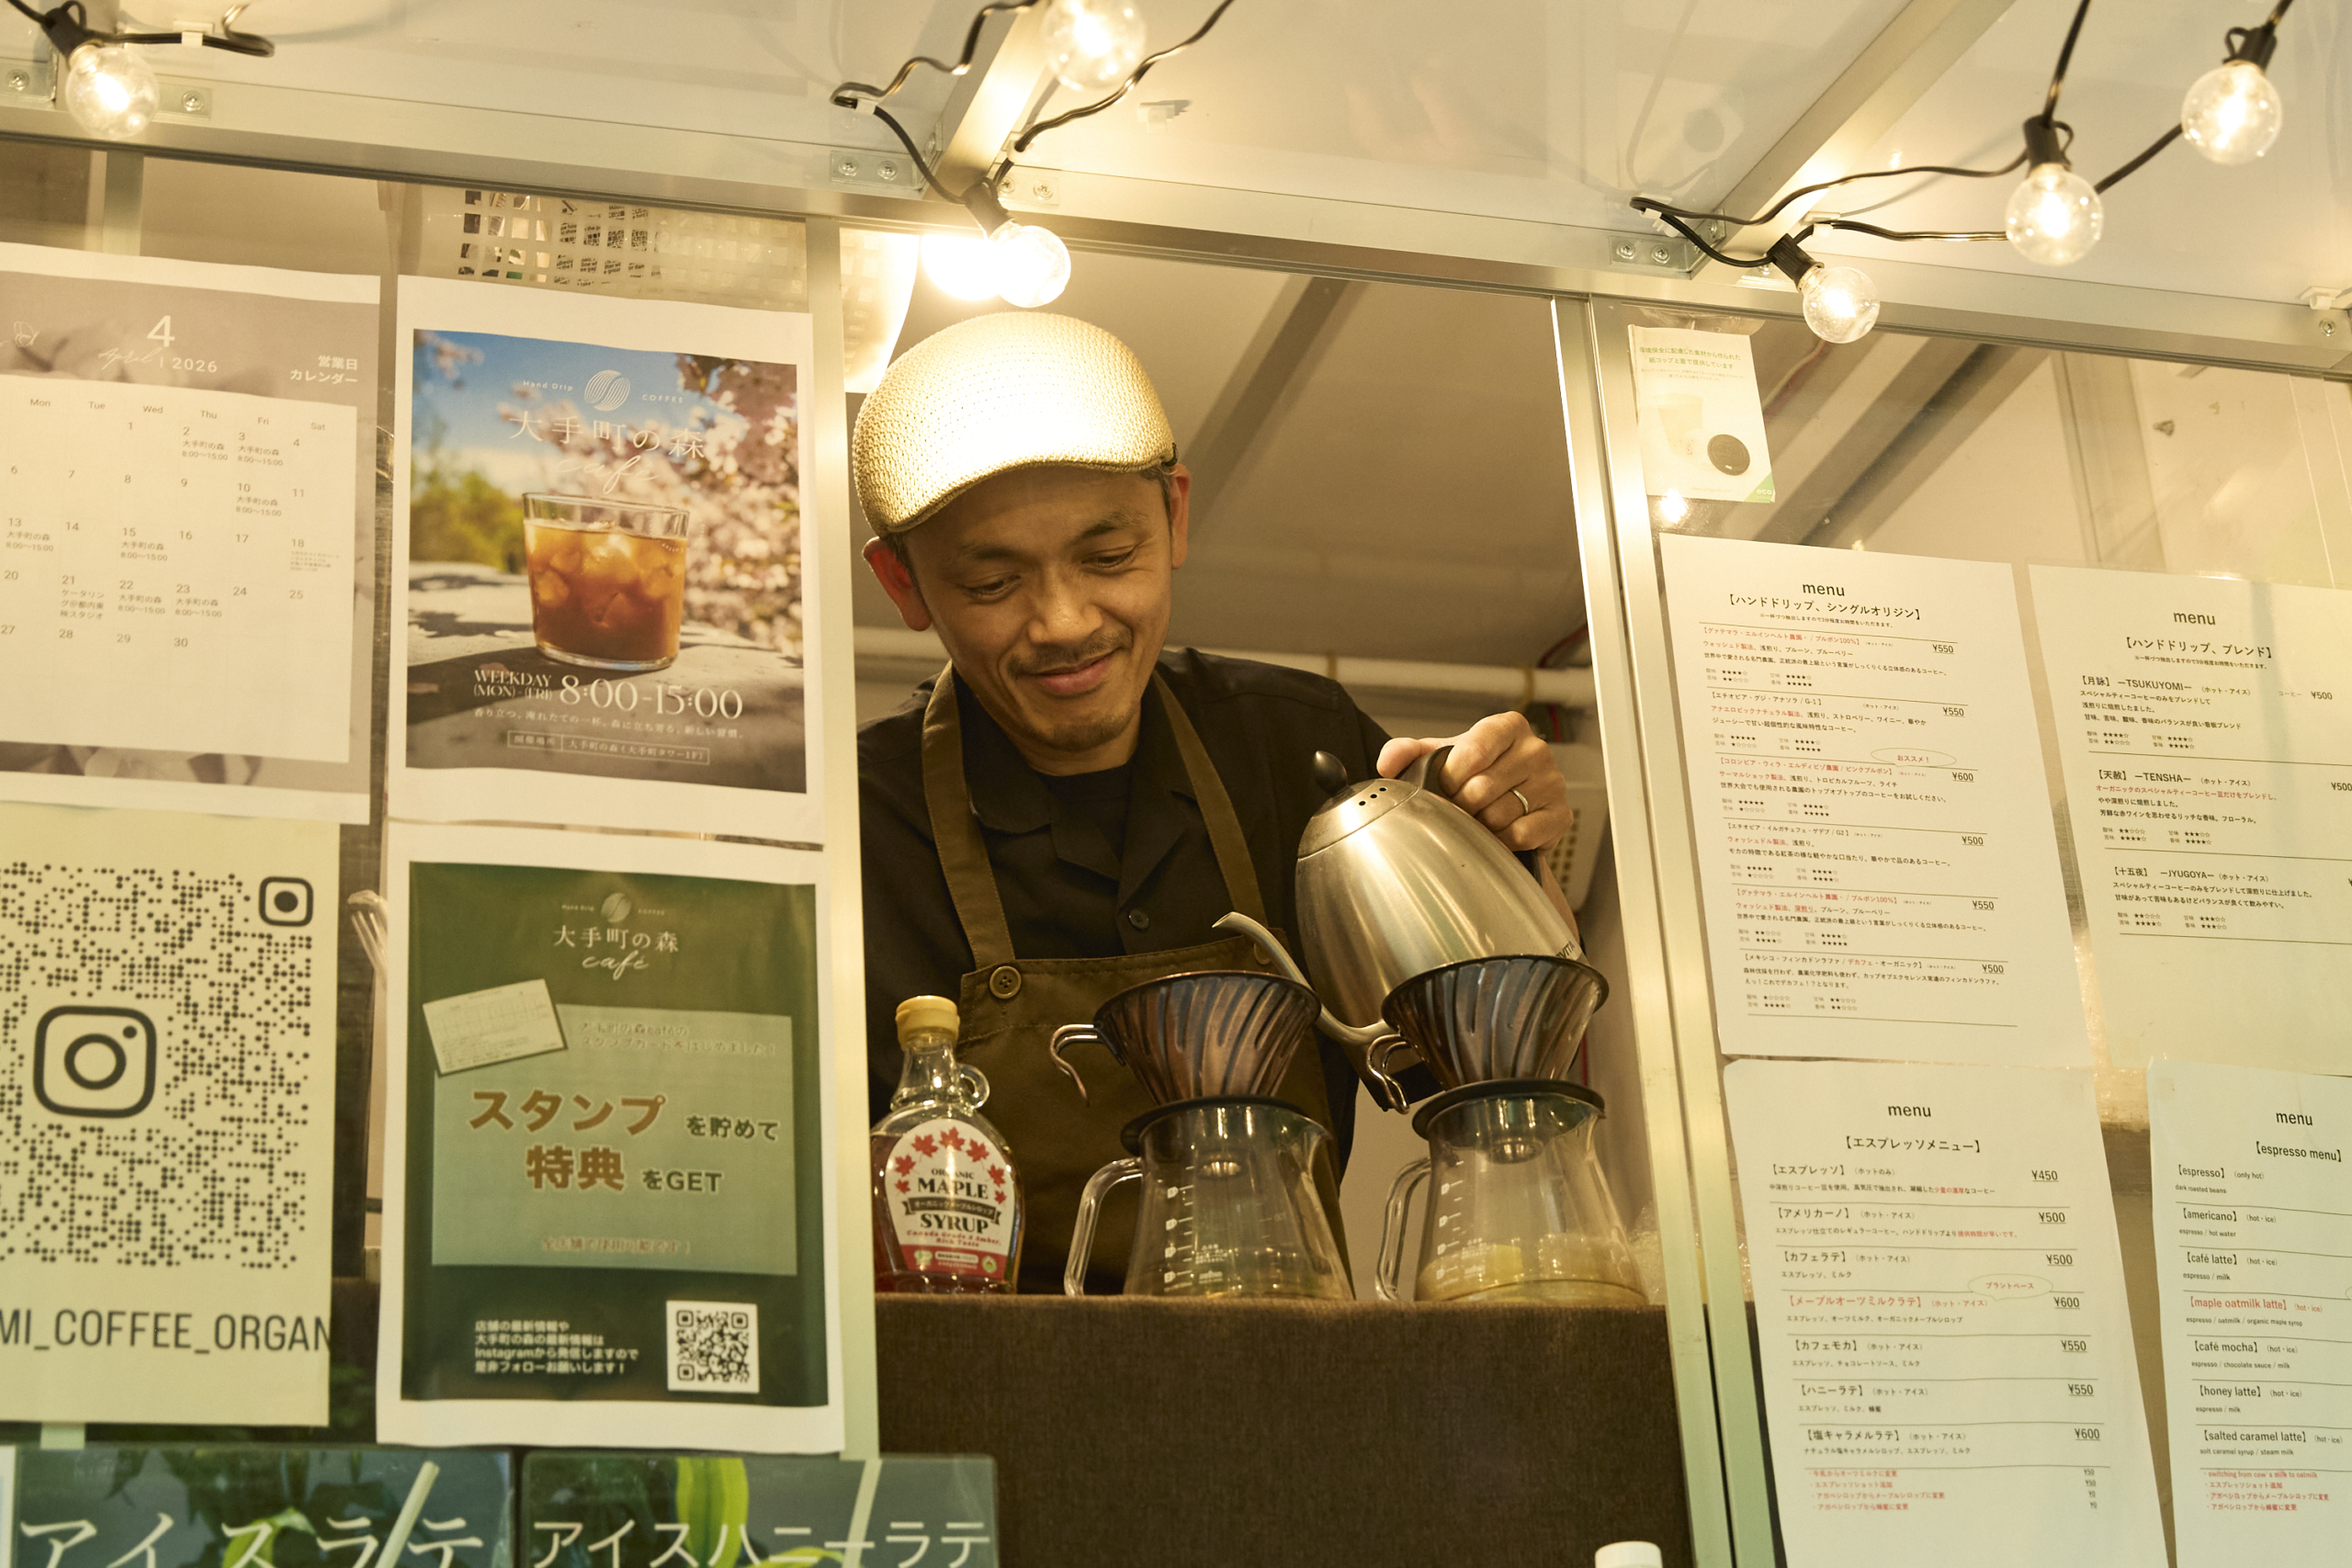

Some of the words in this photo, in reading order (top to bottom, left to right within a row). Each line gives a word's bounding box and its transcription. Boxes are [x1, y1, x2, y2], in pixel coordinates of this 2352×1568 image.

[146, 314, 175, 347] 4
[172, 357, 218, 374] 2026
[318, 355, 358, 370] 営業日
[289, 368, 358, 385] カレンダー
[523, 380, 548, 390] Hand
[552, 382, 573, 392] Drip
[642, 394, 684, 403] COFFEE
[29, 399, 51, 408] Mon
[88, 401, 106, 410] Tue
[142, 405, 164, 414] Wed
[200, 410, 218, 420] Thu
[258, 416, 269, 426] Fri
[311, 421, 326, 431] Sat
[128, 422, 133, 431] 1
[183, 426, 190, 436] 2
[238, 432, 245, 441] 3
[293, 438, 300, 447] 4
[509, 411, 705, 459] 大手町の森
[11, 466, 17, 475] 6
[68, 470, 75, 479] 7
[124, 475, 131, 484] 8
[181, 479, 187, 488] 9
[238, 483, 251, 492] 10
[293, 489, 305, 497] 11
[7, 517, 22, 527] 13
[65, 522, 80, 531] 14
[122, 527, 136, 536] 15
[179, 531, 193, 540] 16
[235, 534, 249, 543] 17
[291, 538, 305, 547] 18
[4, 570, 18, 581] 20
[62, 575, 75, 585] 21
[119, 581, 134, 590] 22
[175, 584, 190, 594] 23
[232, 587, 247, 596] 24
[289, 590, 303, 600] 25
[1803, 582, 1845, 597] menu
[1729, 593, 1921, 621] 【ハンドドリップ、シングルオリジン】
[2174, 612, 2216, 626] menu
[1, 625, 16, 635] 27
[59, 629, 74, 639] 28
[117, 634, 130, 643] 29
[175, 638, 188, 648] 30
[1933, 644, 1954, 653] ¥550
[2126, 637, 2272, 659] 【ハンドドリップ、ブレンド】
[475, 670, 552, 688] WEEKDAY
[2311, 691, 2333, 701] ¥500
[1942, 707, 1964, 716] ¥550
[1951, 772, 1973, 782] ¥600
[2331, 782, 2352, 792] ¥500
[1962, 836, 1984, 845] ¥500
[2114, 867, 2148, 877] 【十五夜】
[1973, 900, 1995, 909] ¥550
[553, 925, 679, 953] 大手町の森
[1982, 964, 2005, 974] ¥500
[469, 1089, 666, 1135] スタンプ
[686, 1116, 779, 1139] を貯めて
[1888, 1104, 1931, 1118] menu
[2276, 1112, 2313, 1125] menu
[1846, 1136, 1982, 1153] 【エスプレッソメニュー】
[525, 1145, 625, 1191] 特典
[643, 1169, 722, 1192] をGET
[1773, 1165, 1844, 1177] 【エスプレッソ】
[2031, 1170, 2058, 1181] ¥450
[918, 1178, 989, 1200] MAPLE
[1778, 1207, 1849, 1219] 【アメリカーノ】
[2039, 1212, 2065, 1223] ¥500
[921, 1213, 989, 1234] SYRUP
[1784, 1251, 1847, 1263] 【カフェラテ】
[2046, 1254, 2073, 1265] ¥500
[1790, 1295, 1922, 1307] 【メープルオーツミルクラテ】
[2054, 1296, 2080, 1307] ¥600
[2225, 1297, 2260, 1309] oatmilk
[1794, 1340, 1858, 1351] 【カフェモカ】
[2061, 1340, 2086, 1351] ¥550
[1801, 1385, 1863, 1396] 【ハニーラテ】
[2068, 1384, 2094, 1395] ¥550
[1806, 1429, 1899, 1440] 【塩キャラメルラテ】
[2075, 1428, 2100, 1439] ¥600
[2240, 1432, 2278, 1441] caramel
[534, 1519, 990, 1568] アイスハニーラテ
